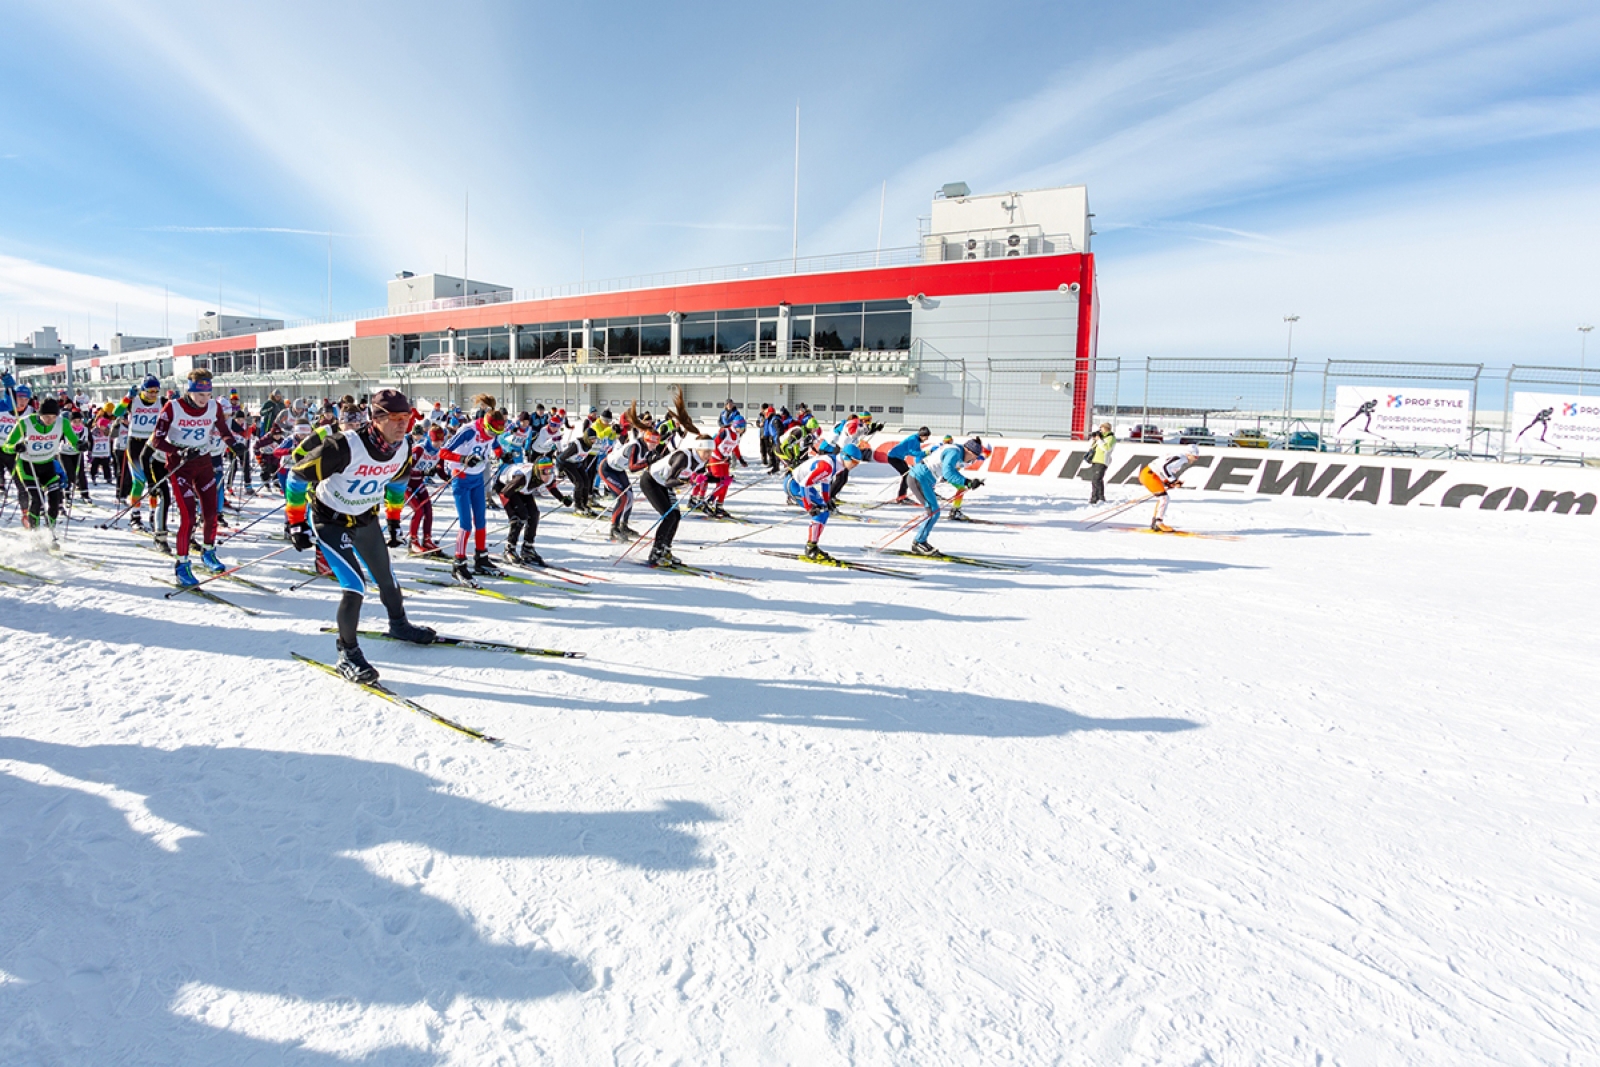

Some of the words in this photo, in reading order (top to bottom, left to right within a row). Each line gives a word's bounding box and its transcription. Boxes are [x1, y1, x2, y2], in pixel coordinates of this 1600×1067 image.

[1405, 398, 1432, 407] PROF
[1434, 399, 1464, 409] STYLE
[132, 414, 158, 426] 104
[178, 419, 212, 428] ДЮСШ
[1377, 414, 1462, 426] Профессиональная
[28, 434, 58, 442] ДЮСШ
[180, 427, 206, 440] 78
[31, 441, 54, 452] 66
[95, 443, 107, 451] 21
[354, 463, 400, 477] ДЮСШ
[1057, 450, 1598, 516] RAEWAYcom
